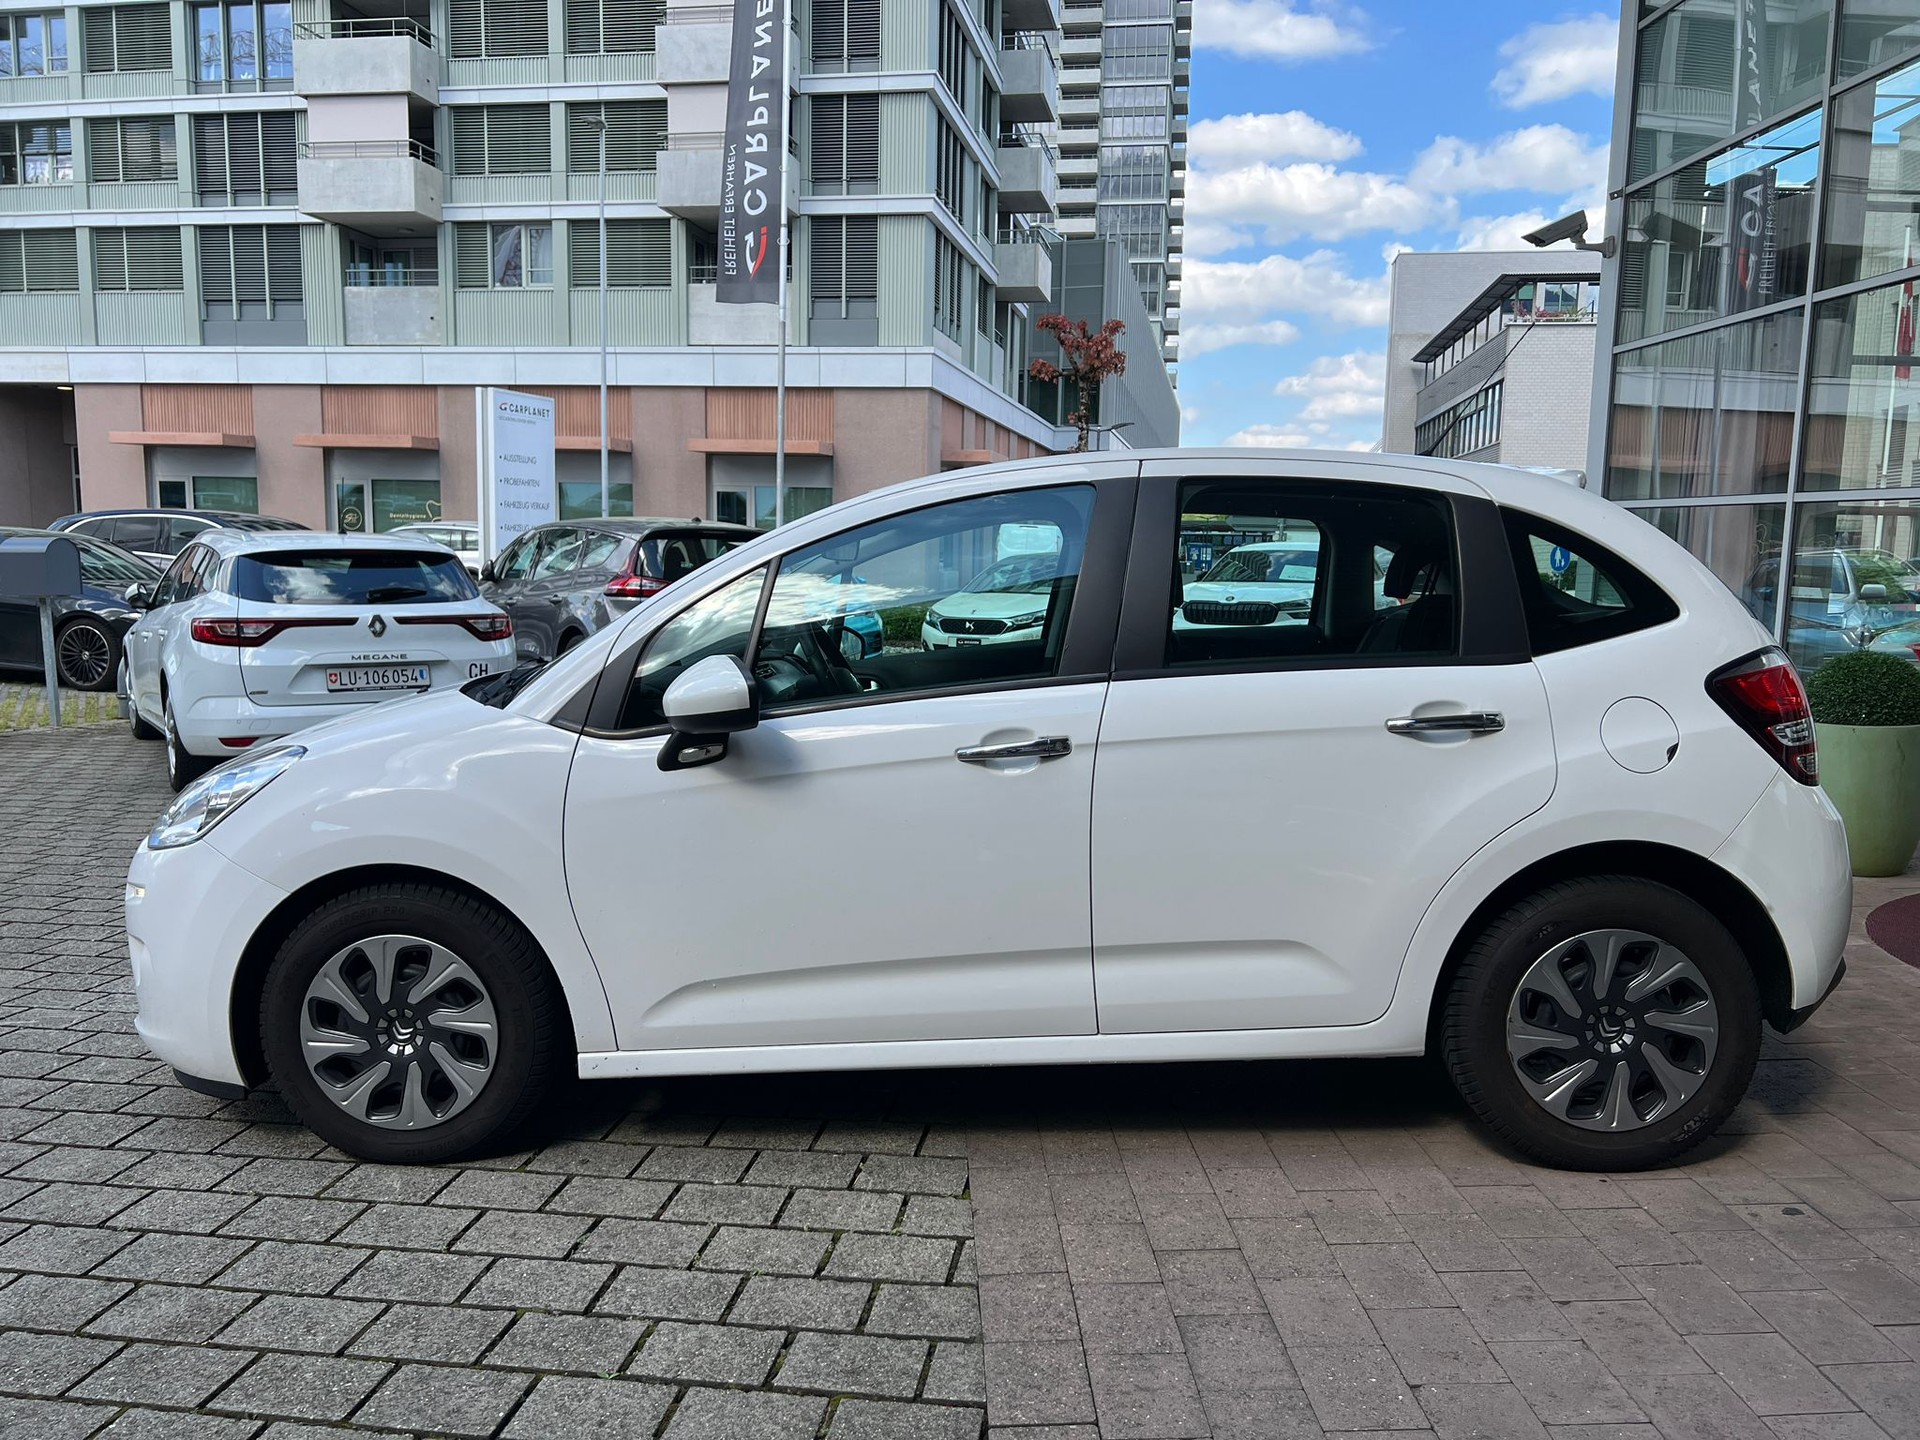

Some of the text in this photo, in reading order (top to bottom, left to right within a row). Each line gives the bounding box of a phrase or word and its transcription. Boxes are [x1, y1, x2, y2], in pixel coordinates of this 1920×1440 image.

[509, 403, 550, 418] CARPLANET
[503, 454, 537, 464] AUSSTELLUNG
[503, 478, 540, 488] PROBEFAHRTEN
[504, 500, 550, 510] FAHRZEUG VERKAUF
[389, 512, 426, 520] Dentalhygiene
[469, 663, 488, 678] CH
